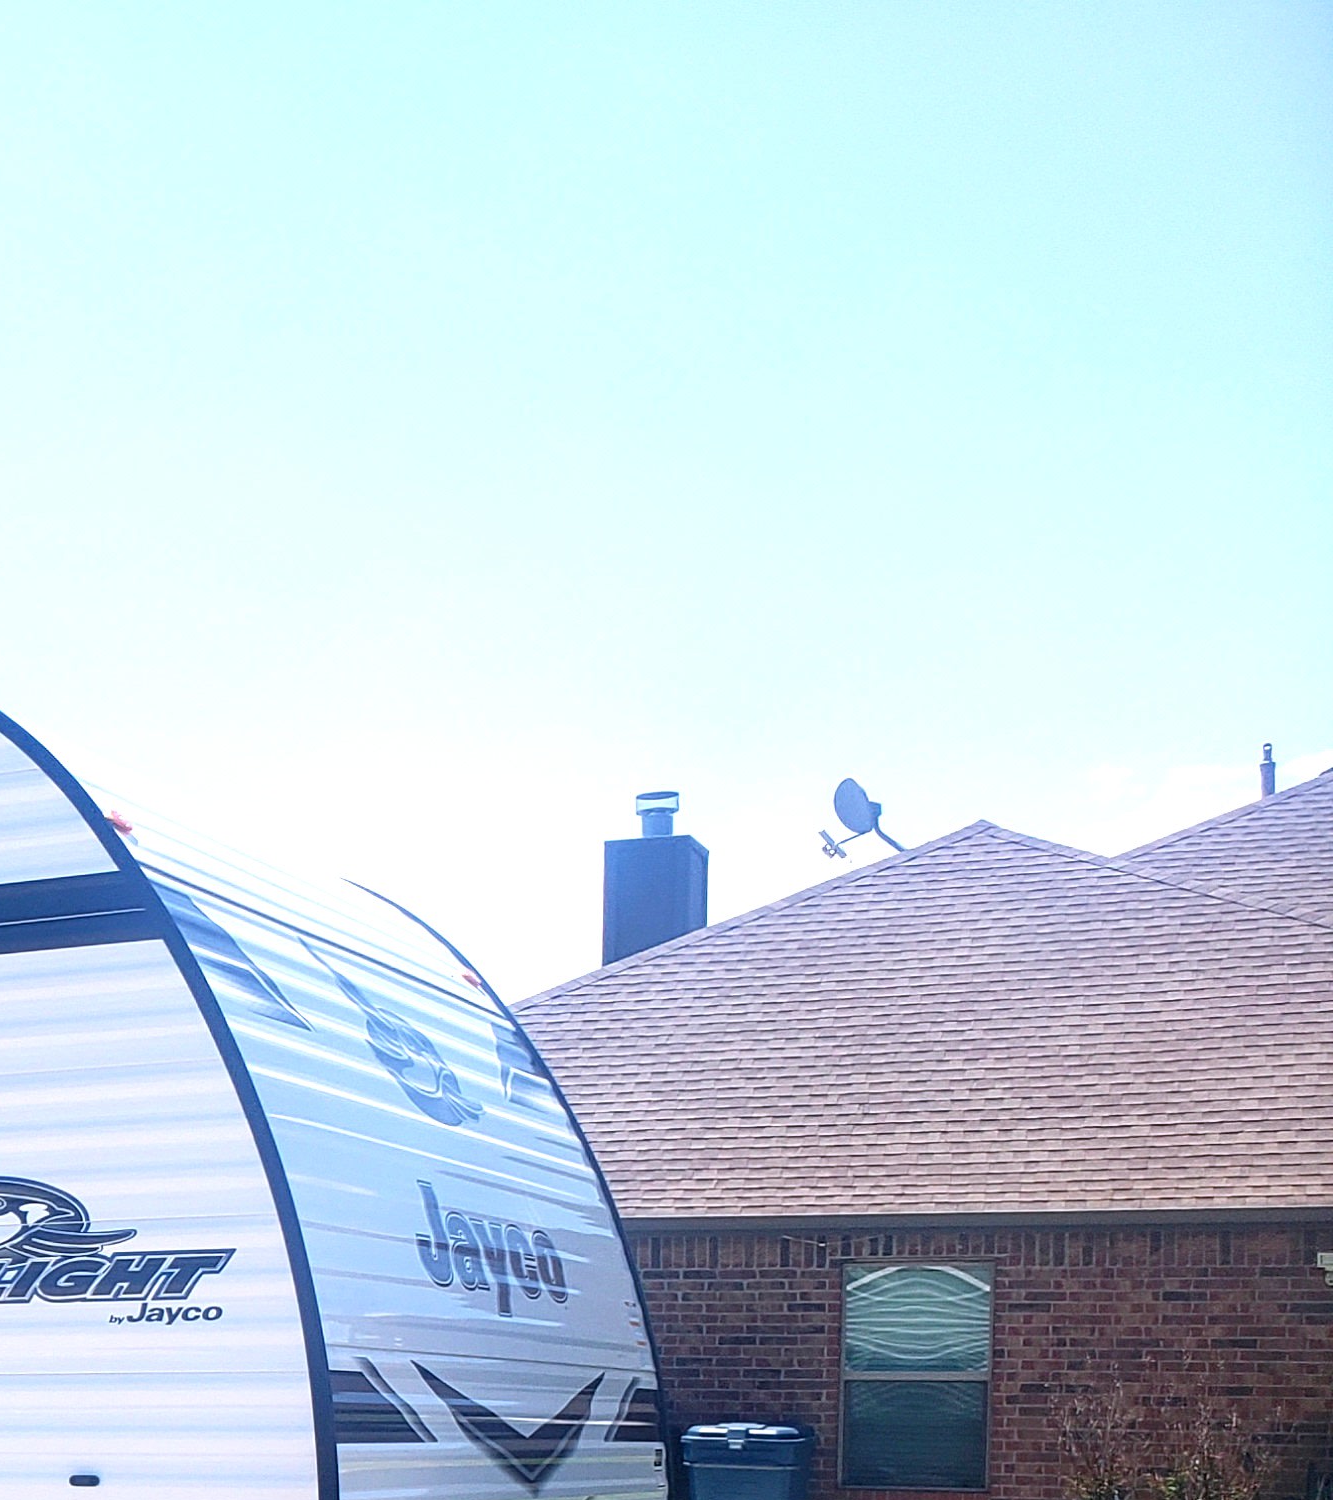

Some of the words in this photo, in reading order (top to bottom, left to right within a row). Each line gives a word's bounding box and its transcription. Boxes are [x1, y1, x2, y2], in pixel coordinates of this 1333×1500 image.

[415, 1179, 568, 1317] Jayco
[109, 1315, 125, 1325] by
[126, 1302, 223, 1325] Jayco
